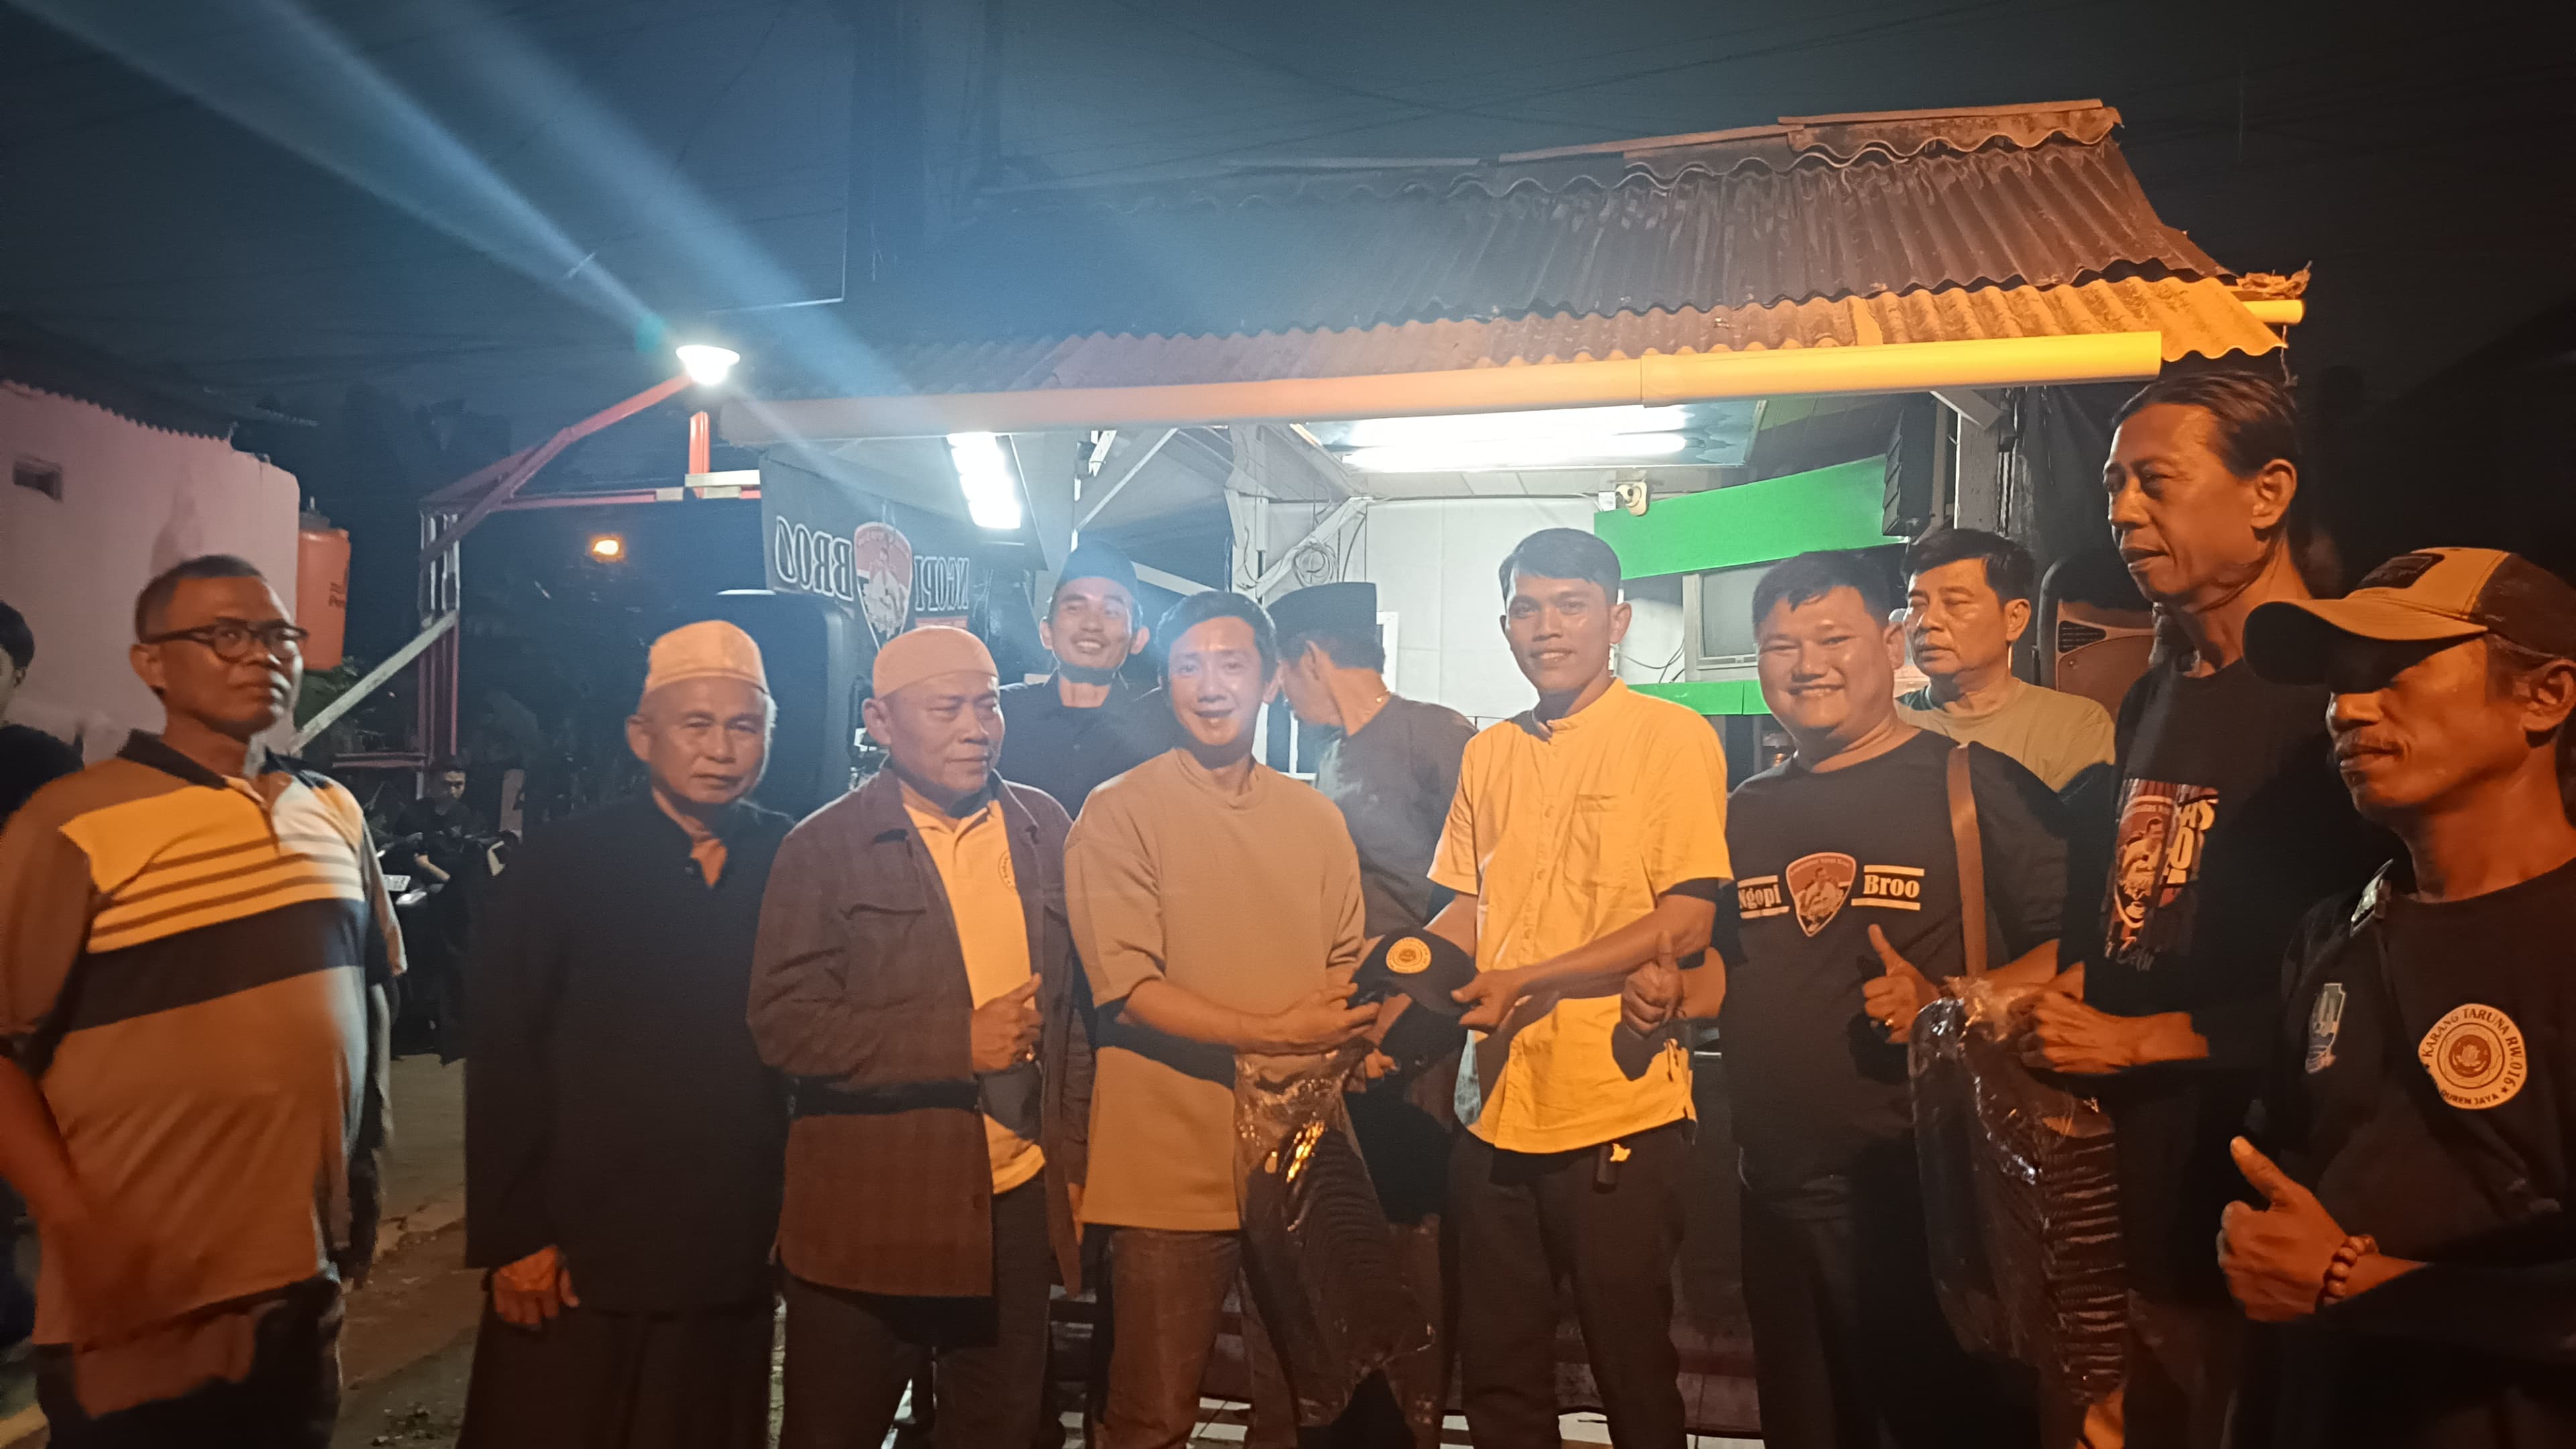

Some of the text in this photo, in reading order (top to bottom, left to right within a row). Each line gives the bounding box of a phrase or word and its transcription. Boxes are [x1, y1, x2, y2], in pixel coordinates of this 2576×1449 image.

[1737, 874, 1921, 909] Ngopi Broo
[2421, 1012, 2459, 1057] KARANG
[2463, 1008, 2510, 1035] TARUNA
[2473, 1093, 2500, 1106] JAYA
